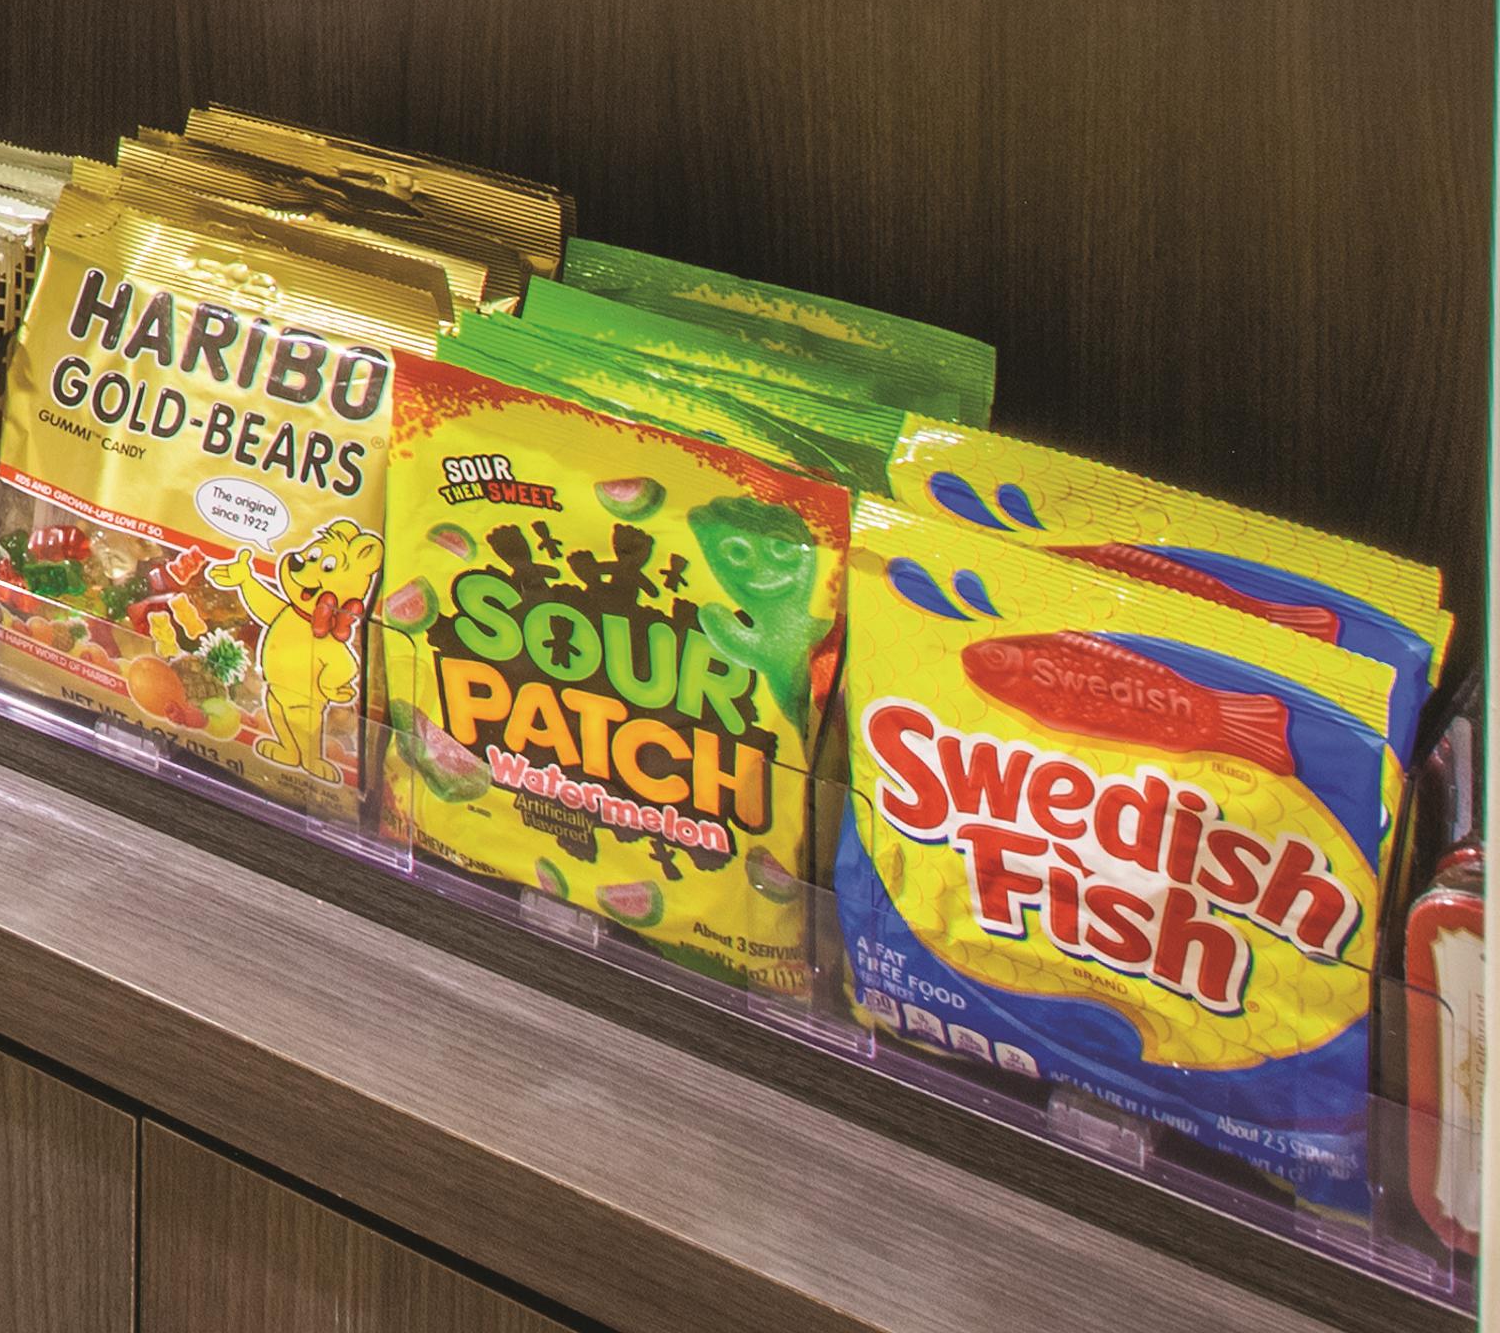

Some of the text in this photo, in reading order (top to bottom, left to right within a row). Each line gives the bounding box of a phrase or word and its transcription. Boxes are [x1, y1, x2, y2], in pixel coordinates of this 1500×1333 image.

[68, 268, 390, 422] HARIBO
[36, 407, 147, 463] GUMMI CANDY
[50, 357, 368, 497] GOLD-BEARS
[439, 482, 486, 506] THEN
[444, 454, 513, 483] SOUR
[211, 503, 268, 532] since 1922
[212, 486, 277, 517] The original
[453, 570, 757, 736] SOUR
[1029, 653, 1196, 720] Swedish
[439, 657, 767, 827] PATCH
[487, 743, 731, 856] Watermelon
[514, 791, 595, 833] Artificially
[522, 808, 590, 845] Flavored
[865, 704, 1361, 955] Swedish
[957, 823, 1249, 1010] Fish
[857, 949, 967, 1010] FREE FOOD
[875, 943, 908, 967] FAT
[1072, 965, 1130, 997] BRAND
[1215, 1114, 1259, 1144] About
